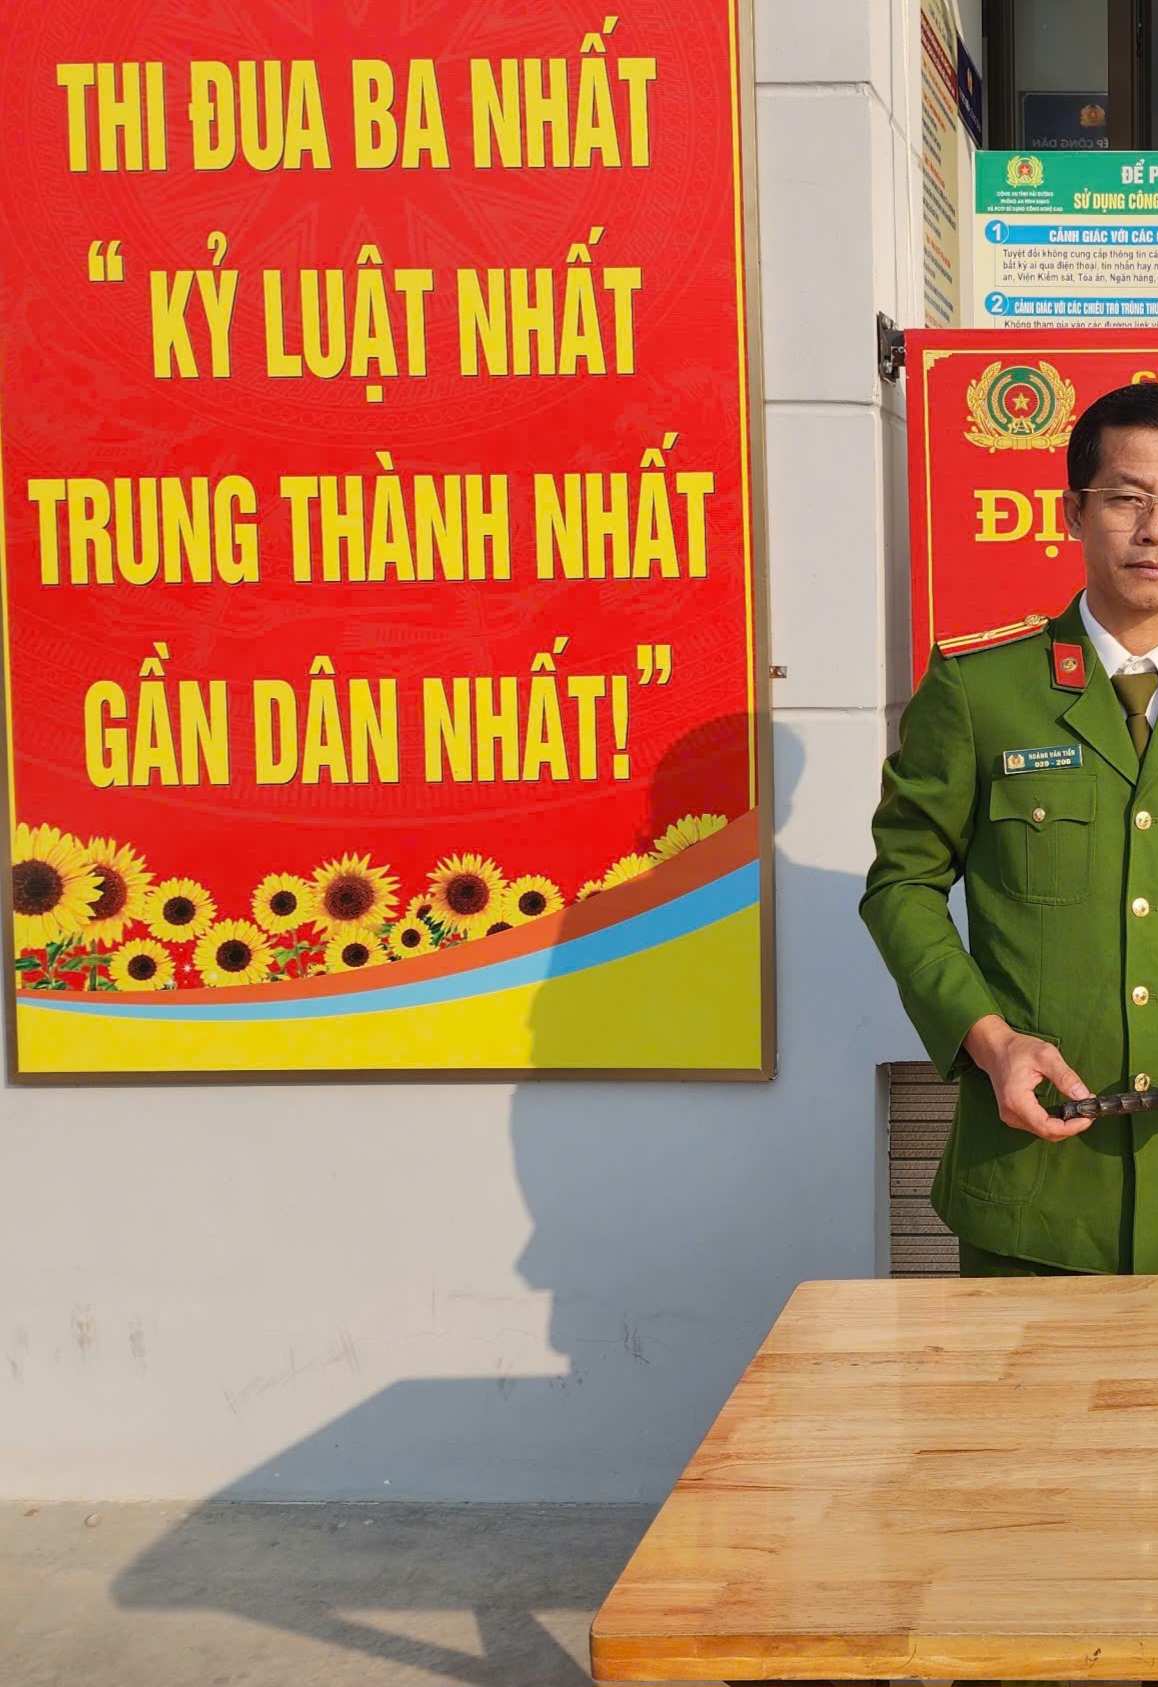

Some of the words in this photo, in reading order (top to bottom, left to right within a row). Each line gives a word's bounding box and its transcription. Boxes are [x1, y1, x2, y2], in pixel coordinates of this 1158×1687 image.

[57, 62, 167, 173] THI
[189, 60, 331, 171] ĐUA
[354, 58, 452, 170] BA
[471, 16, 657, 169] NHẤT
[1121, 159, 1145, 184] ĐỂ
[1073, 187, 1091, 209] SỬ
[1092, 193, 1125, 213] DỤNG
[992, 223, 1001, 241] 1
[1049, 227, 1079, 243] CẢNH
[1082, 229, 1108, 243] GIÁC
[1111, 228, 1129, 243] VỚI
[1131, 228, 1153, 243] CÁC
[1002, 248, 1025, 260] Tuyệt
[1027, 248, 1041, 259] đối
[1042, 248, 1068, 260] không
[1070, 251, 1091, 260] cung
[1110, 248, 1134, 260] thông
[1136, 249, 1147, 258] tin
[1149, 250, 1158, 258] cá
[1002, 260, 1016, 270] bất
[1029, 262, 1038, 270] ai
[1039, 263, 1054, 272] qua
[1056, 260, 1075, 270] điện
[1101, 261, 1112, 270] tin
[1136, 261, 1151, 272] hay
[1002, 274, 1015, 282] an,
[1017, 272, 1036, 282] Viện
[1037, 271, 1059, 282] Kiểm
[1110, 273, 1131, 284] Ngân
[991, 295, 1004, 313] 2
[1014, 298, 1034, 314] CẢNH
[1067, 300, 1083, 314] CÁC
[150, 231, 238, 379] KỶ
[264, 244, 434, 403] LUẬT
[457, 227, 642, 377] NHẤT
[28, 476, 258, 586] TRUNG
[281, 451, 509, 583] THÀNH
[535, 432, 715, 580] NHẤT
[974, 489, 1082, 558] ĐỊ
[84, 642, 227, 787] GẦN
[253, 655, 396, 785] DÂN
[1028, 752, 1048, 760] HOÀNG
[1034, 760, 1050, 768] 029
